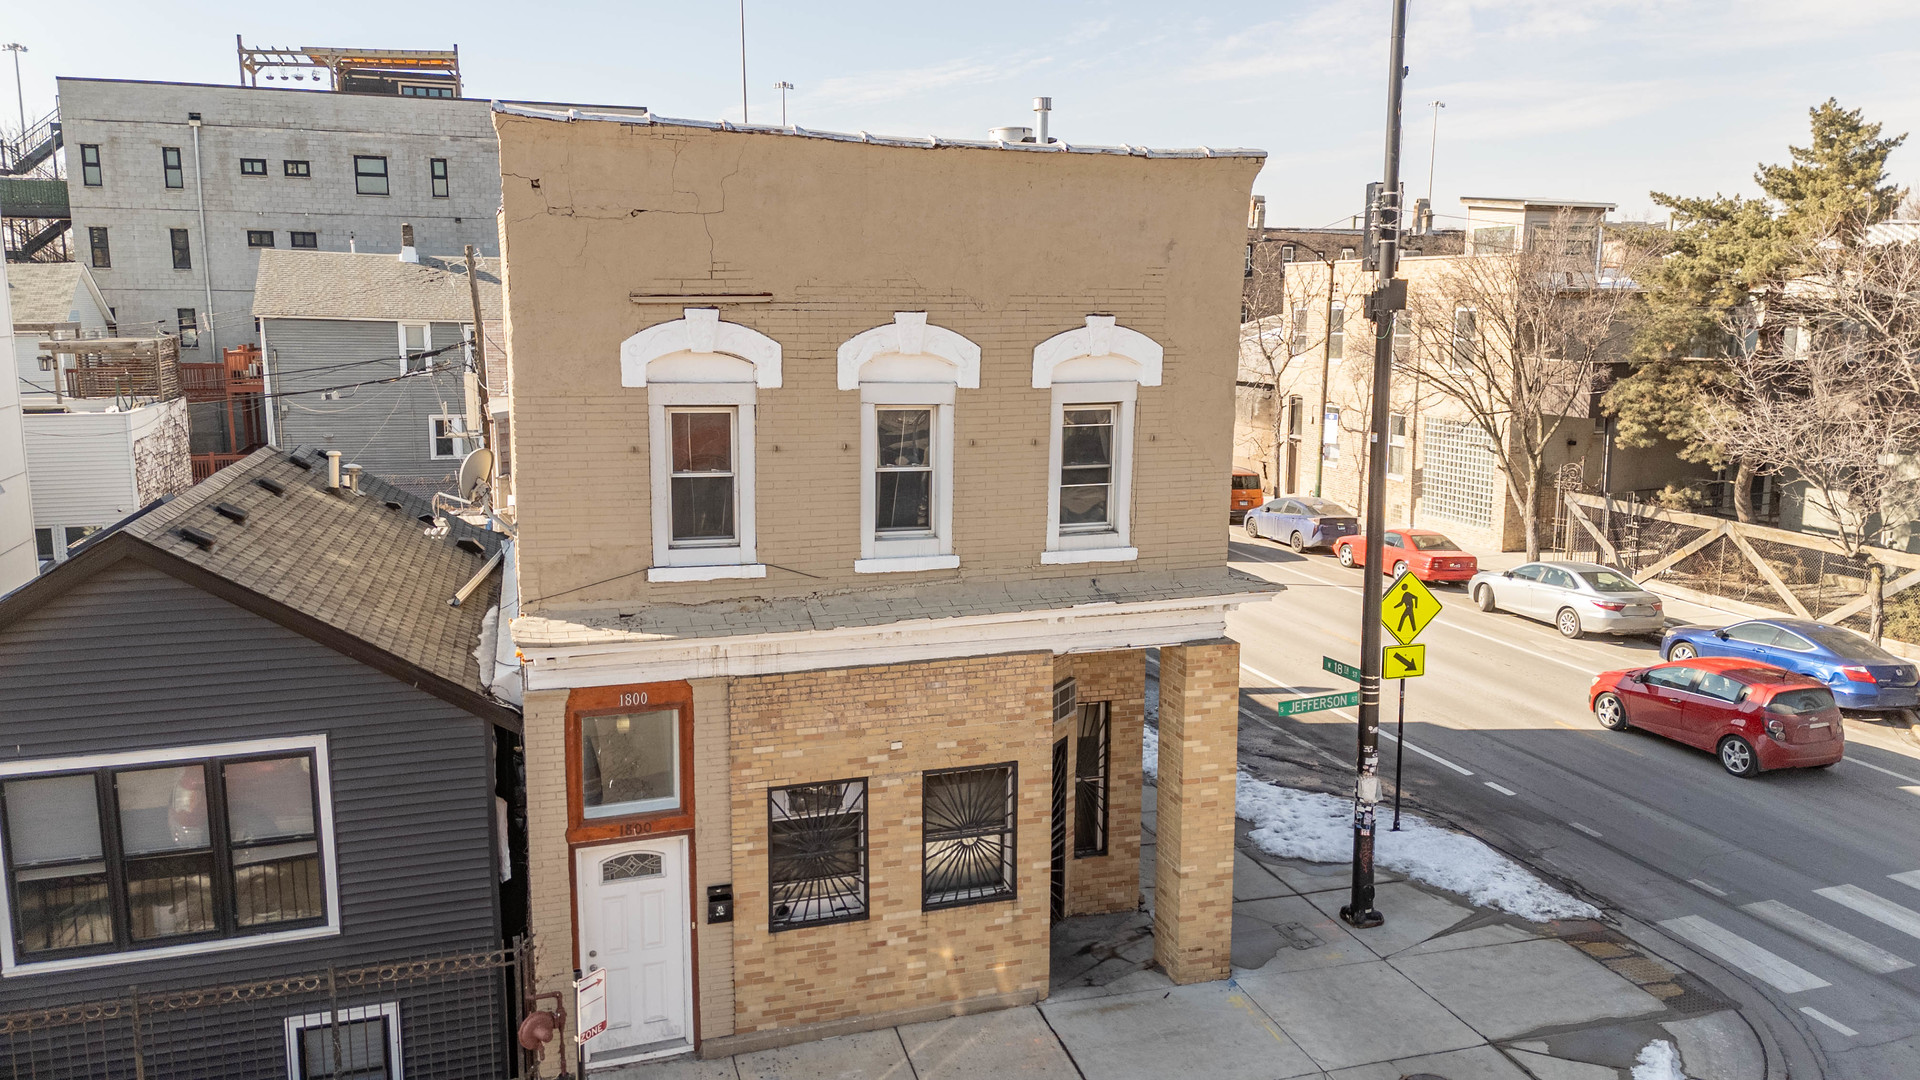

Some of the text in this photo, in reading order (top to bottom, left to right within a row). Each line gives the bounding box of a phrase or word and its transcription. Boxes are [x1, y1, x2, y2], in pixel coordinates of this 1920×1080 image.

[620, 691, 648, 707] 1800
[1288, 694, 1348, 714] JEFFERSON
[1351, 695, 1357, 703] ST
[620, 822, 652, 836] 1800
[580, 1023, 603, 1041] ZONE
